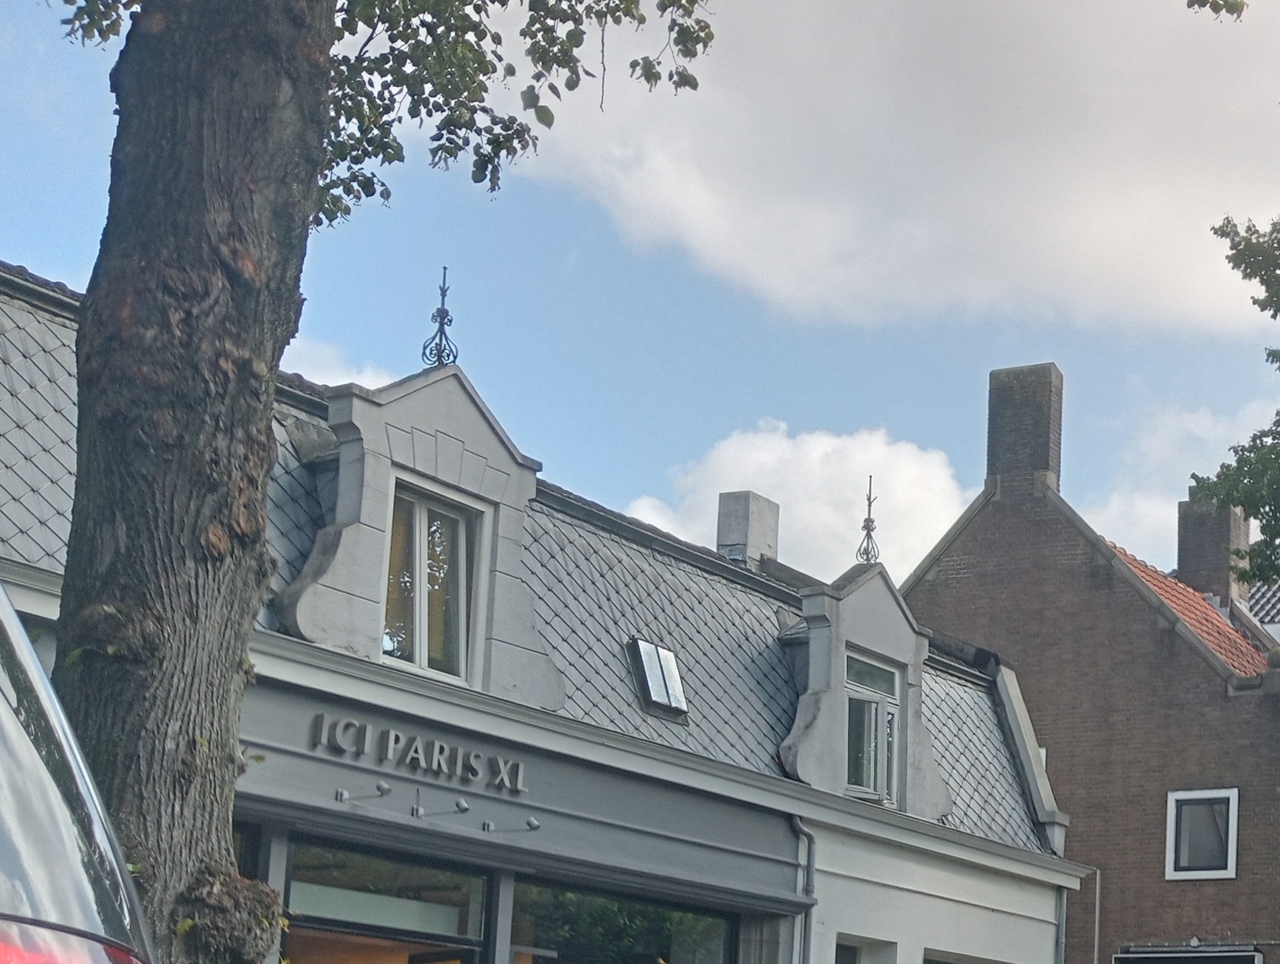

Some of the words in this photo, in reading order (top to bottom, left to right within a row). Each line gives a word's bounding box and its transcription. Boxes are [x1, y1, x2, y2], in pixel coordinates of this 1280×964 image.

[319, 712, 373, 754] ICI
[386, 728, 484, 781] PARIS
[494, 755, 530, 793] XL
